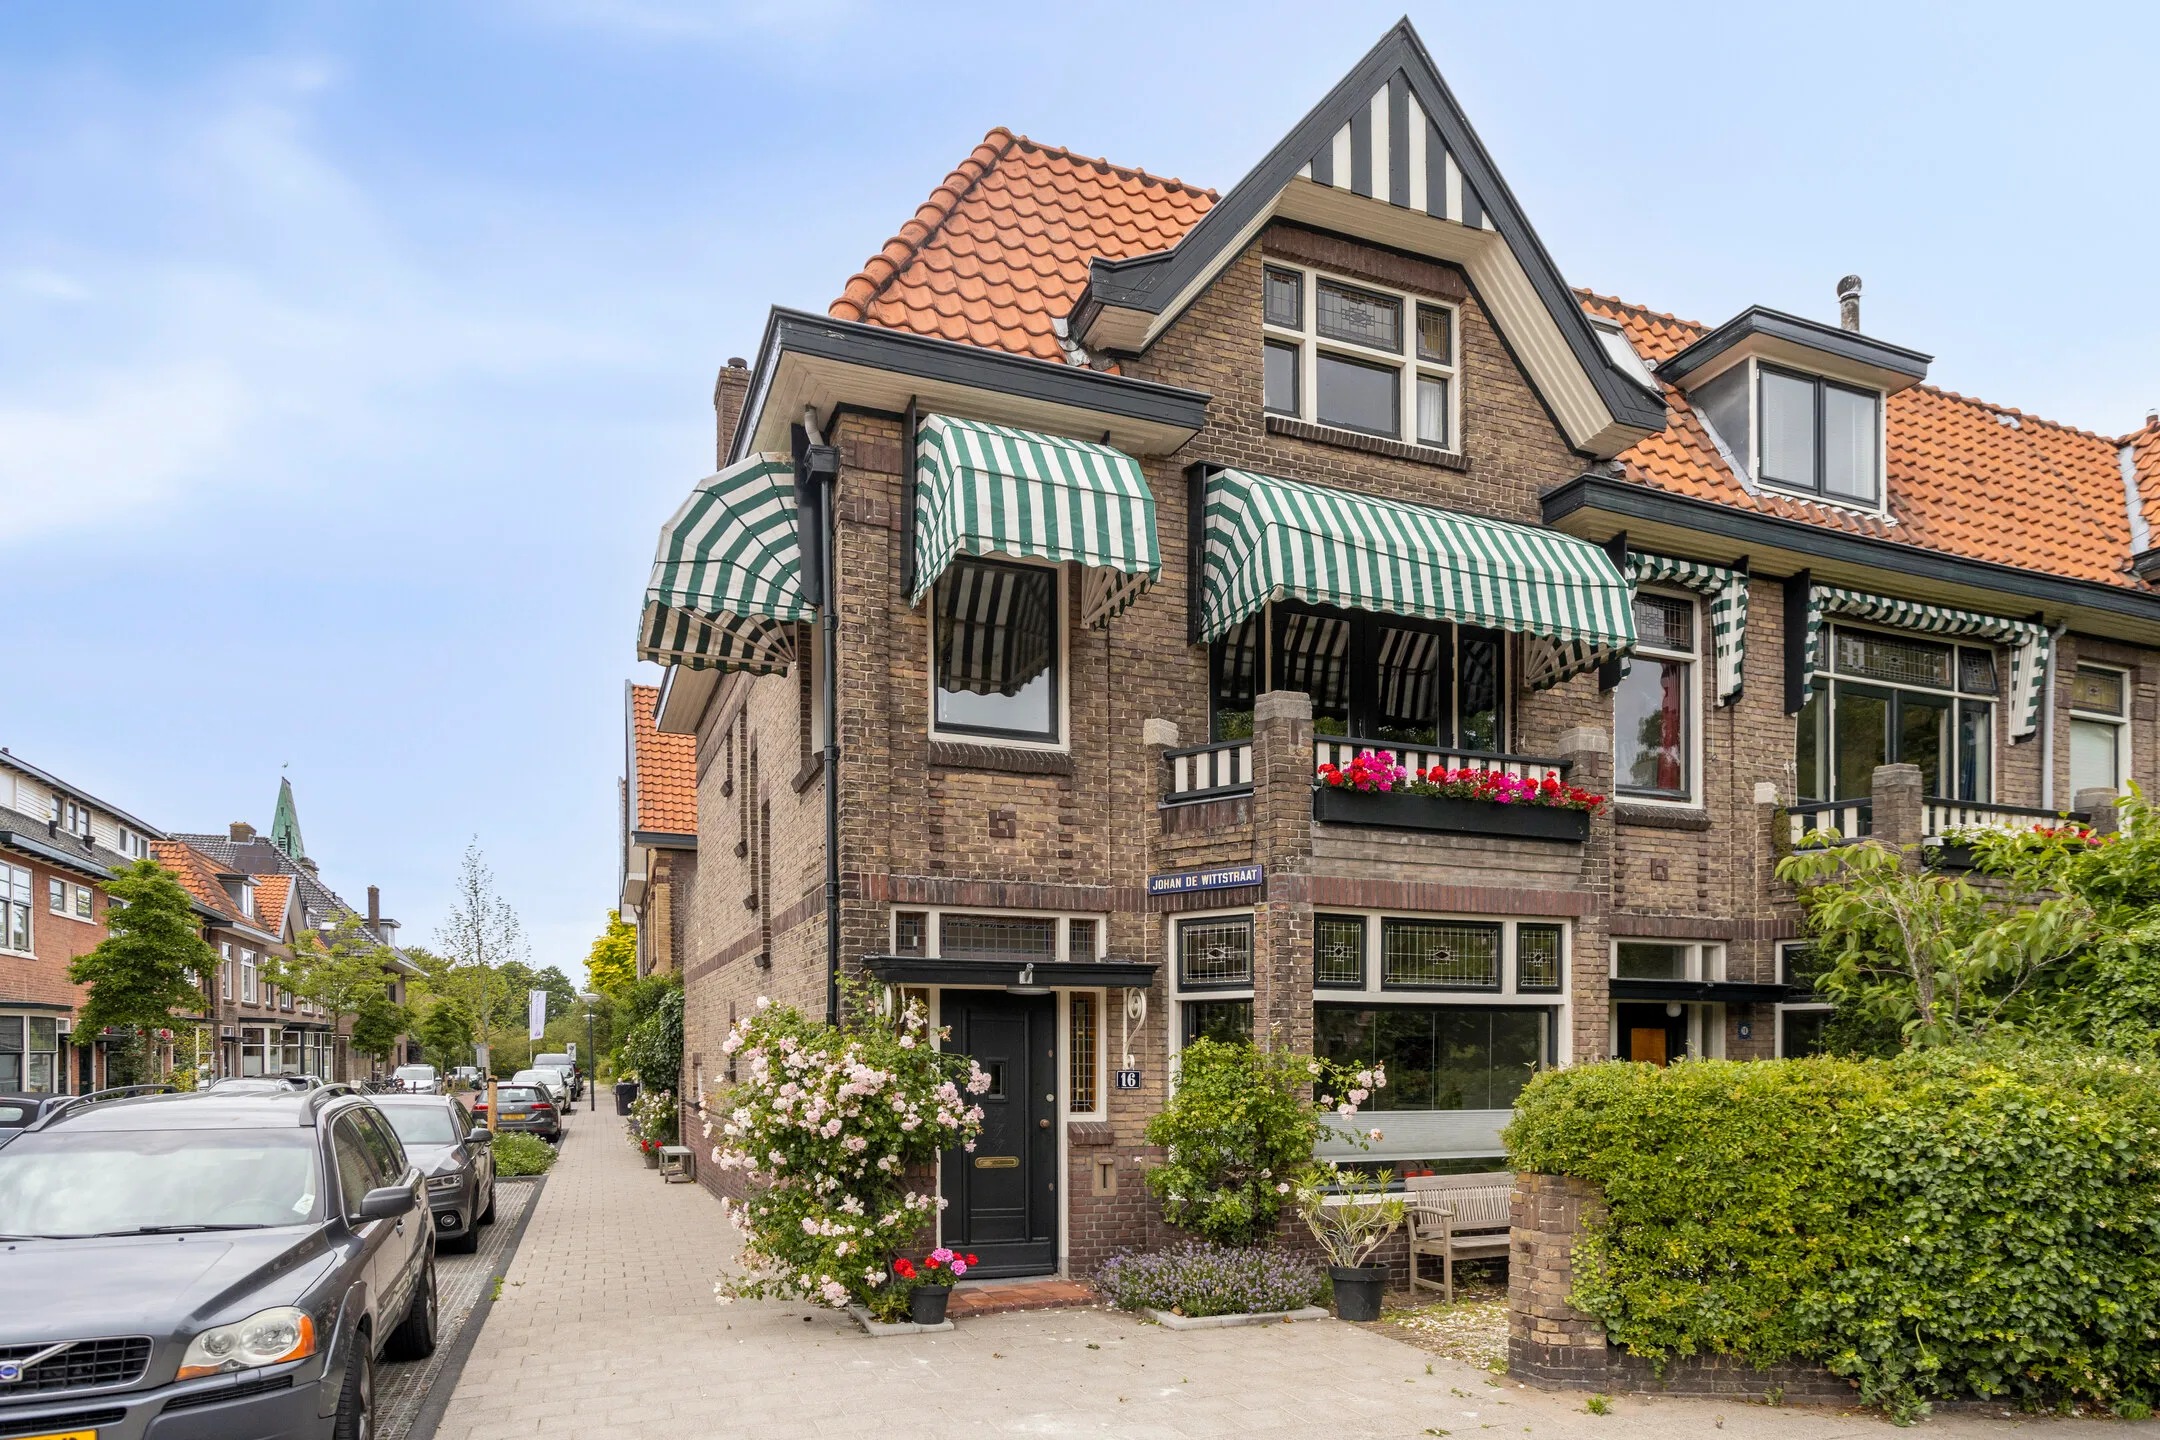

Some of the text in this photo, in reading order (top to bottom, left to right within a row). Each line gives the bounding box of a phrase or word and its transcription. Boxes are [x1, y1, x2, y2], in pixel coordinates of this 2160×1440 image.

[1152, 869, 1257, 890] JOHAN DE WITTSTRAAT
[1121, 1072, 1136, 1087] 16
